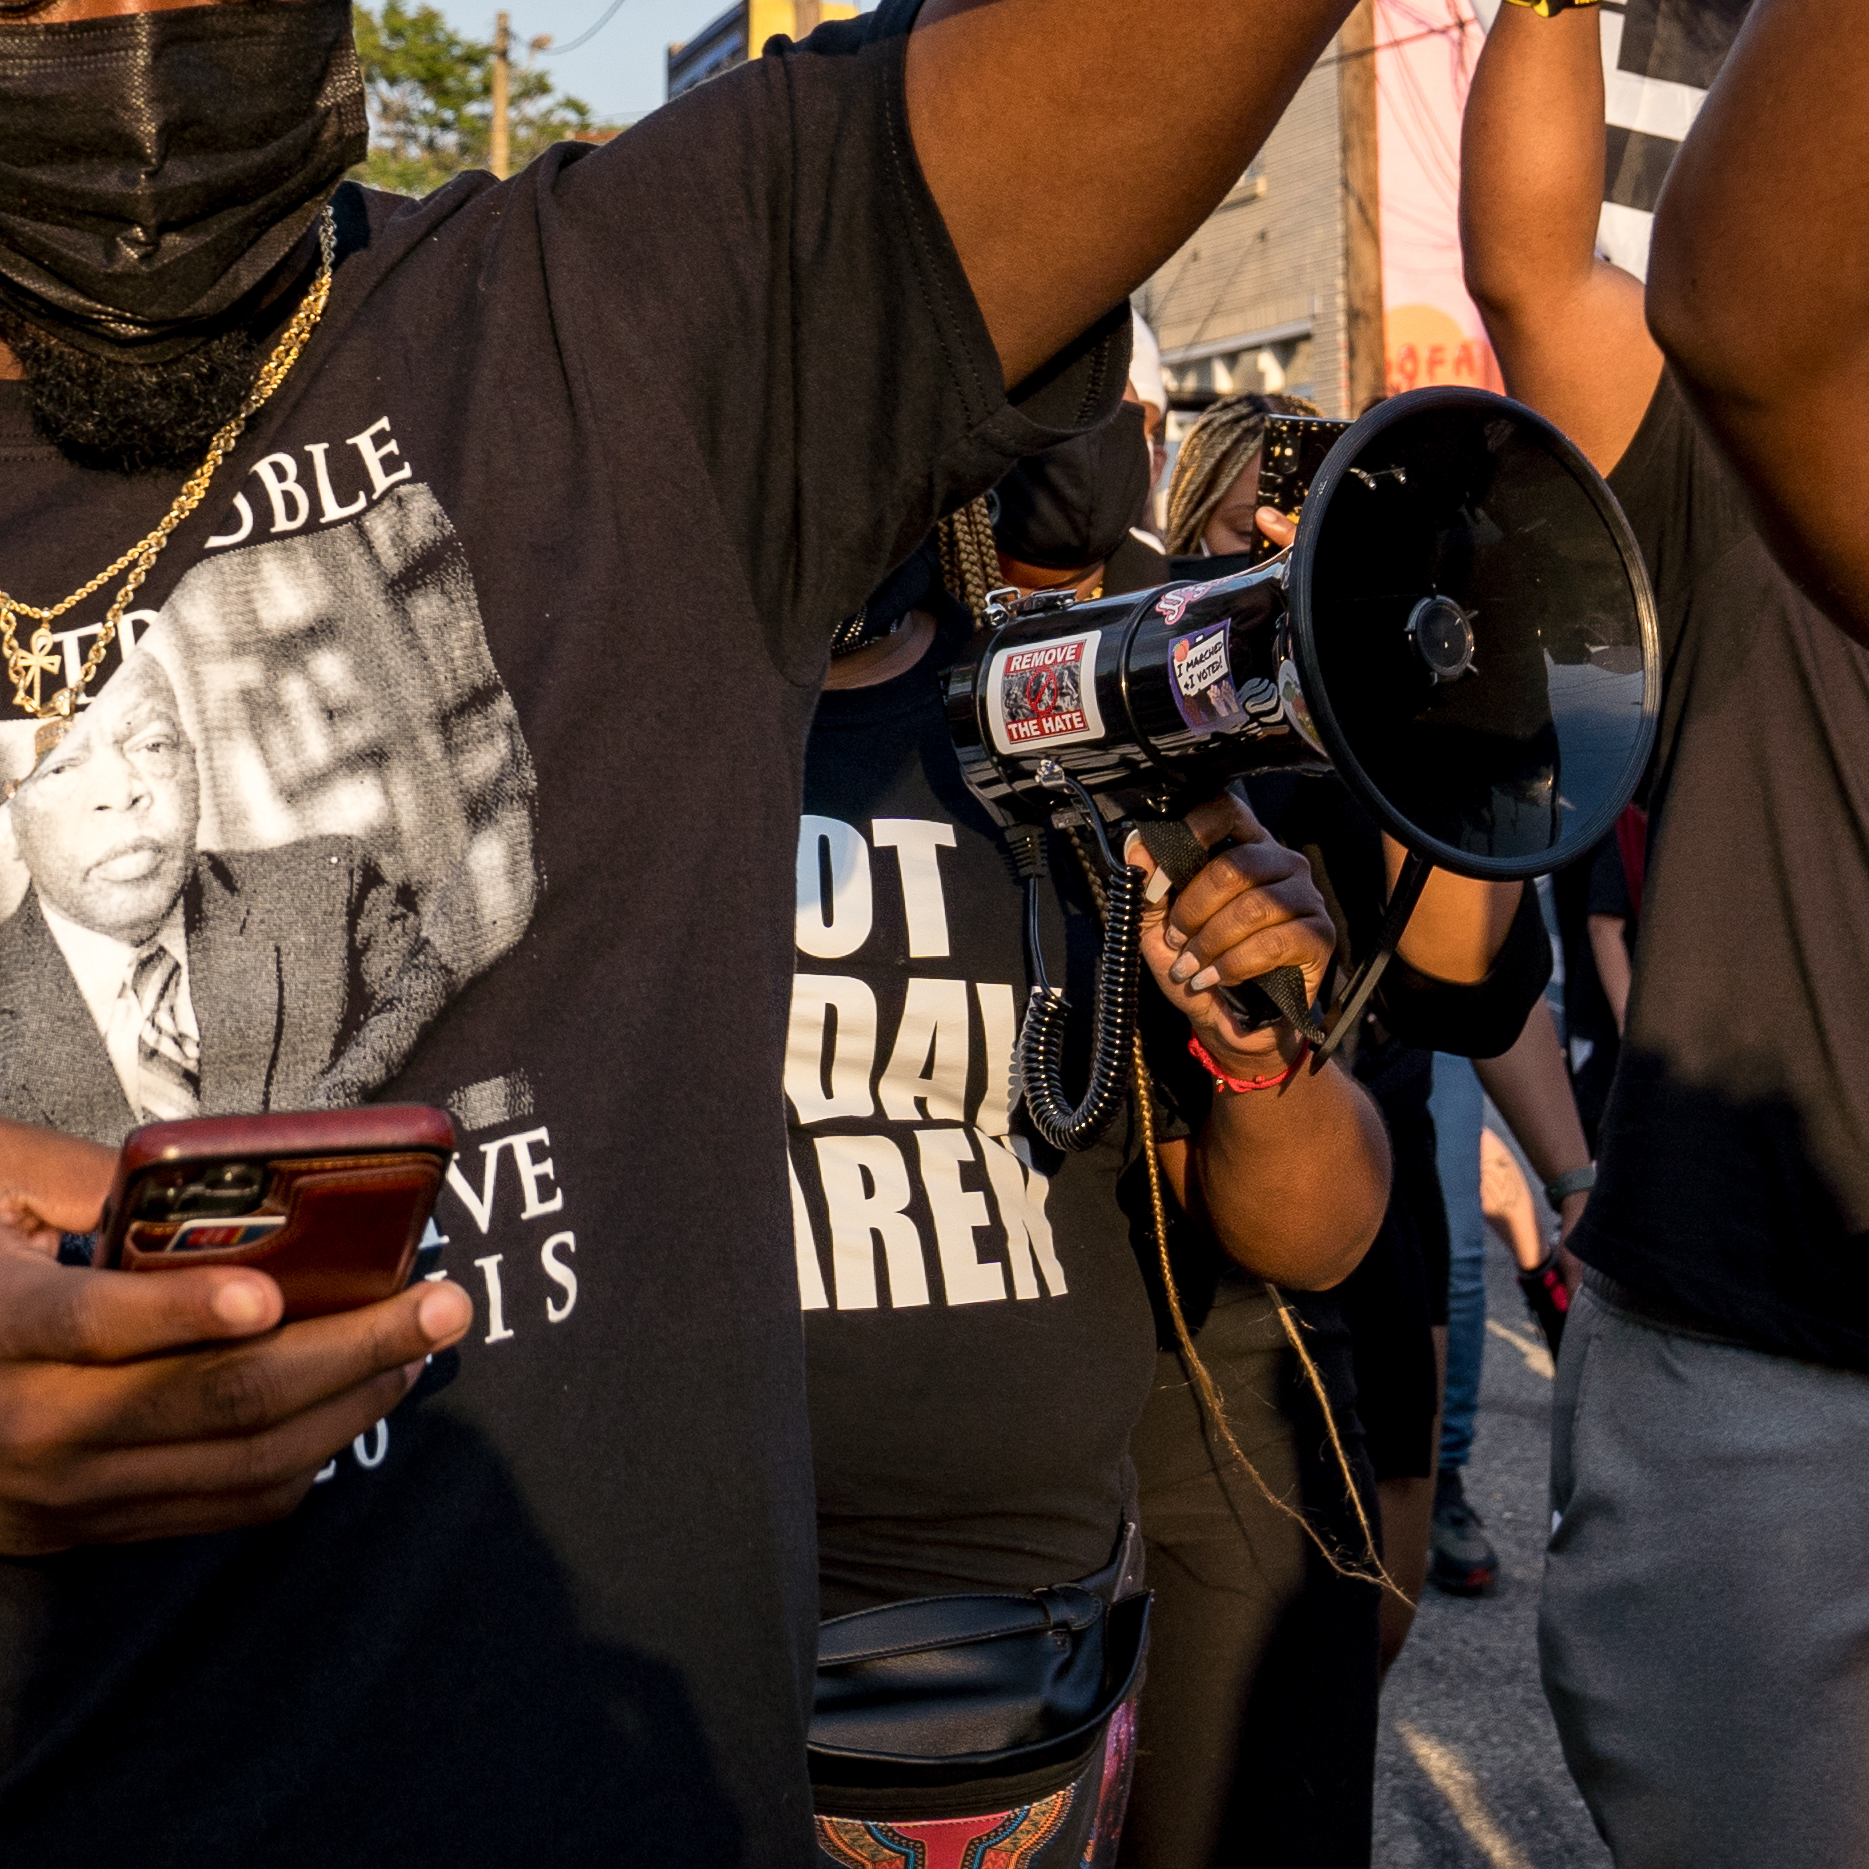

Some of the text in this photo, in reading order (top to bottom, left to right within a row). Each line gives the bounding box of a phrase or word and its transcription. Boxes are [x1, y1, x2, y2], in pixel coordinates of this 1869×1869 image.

[1009, 644, 1078, 671] REMOVE
[1186, 640, 1224, 672] MARCHED
[1007, 711, 1085, 741] THE HATE
